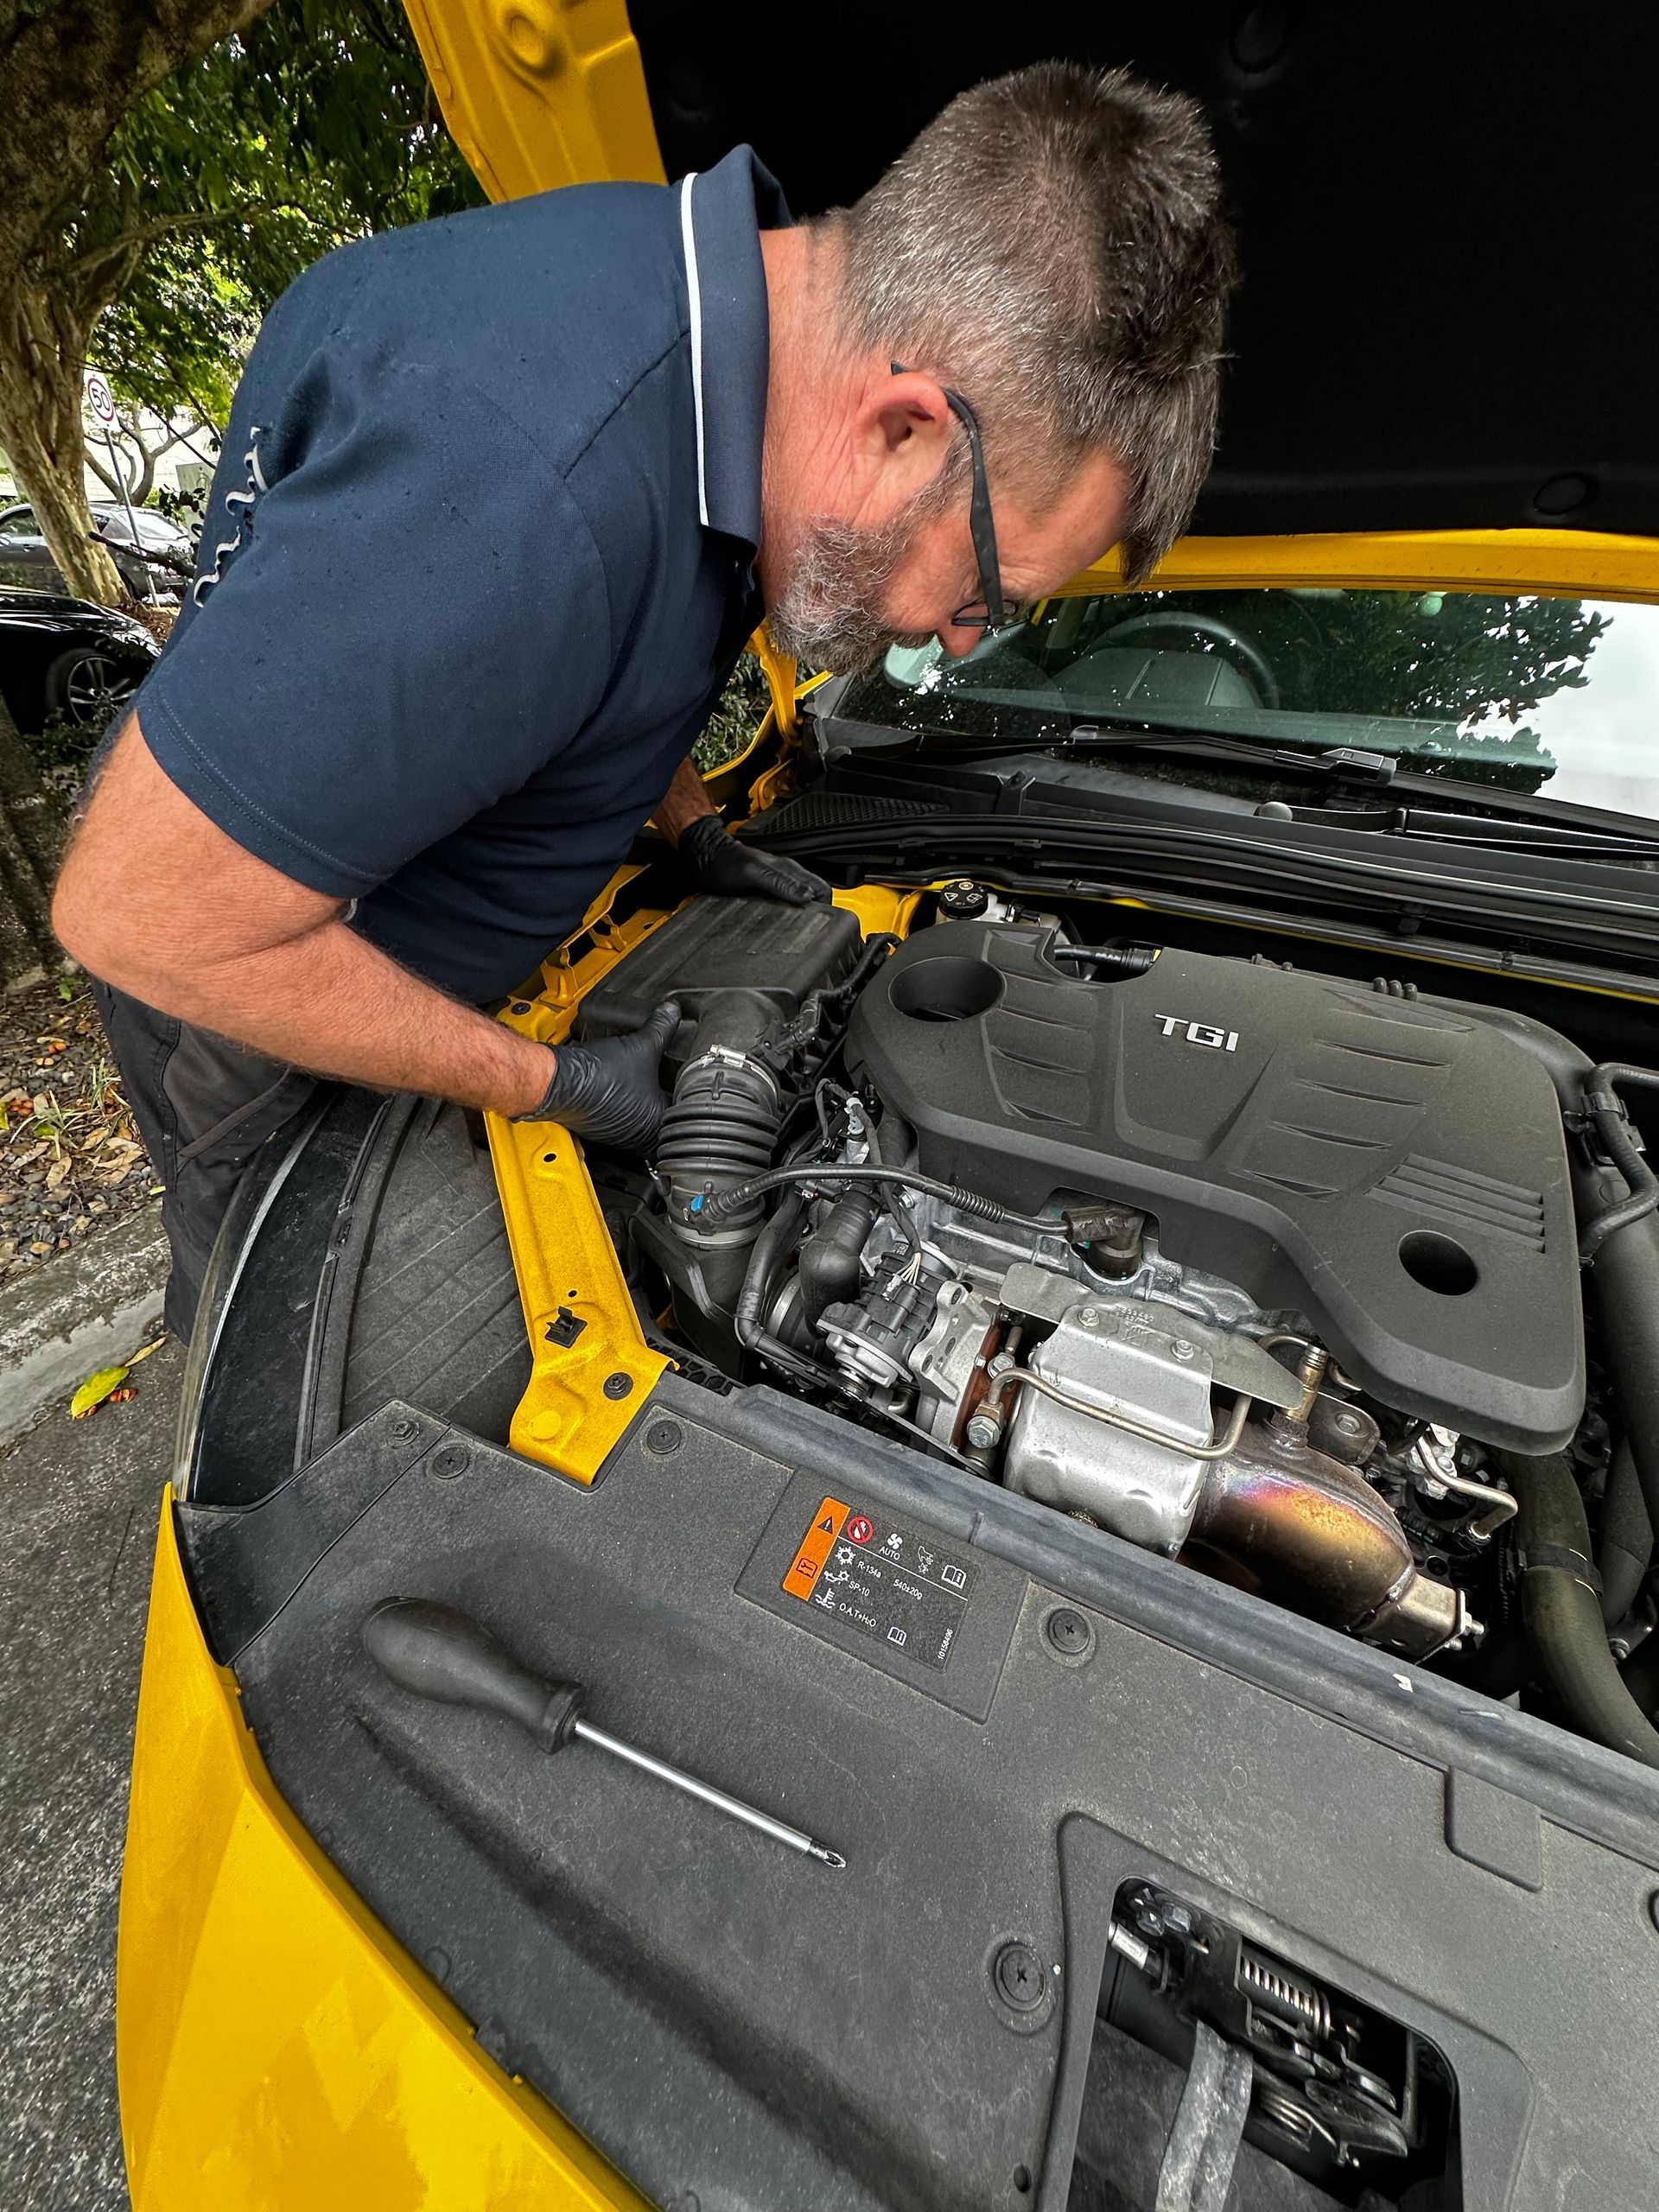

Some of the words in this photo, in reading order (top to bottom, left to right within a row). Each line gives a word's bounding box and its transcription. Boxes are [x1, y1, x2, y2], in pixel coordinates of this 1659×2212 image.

[92, 387, 111, 411] 50
[1154, 1014, 1239, 1052] TGI
[879, 1546, 900, 1560] AUTO
[857, 1560, 881, 1579] R-134a
[849, 1580, 870, 1597] SP-10
[893, 1579, 923, 1600] 540±20g
